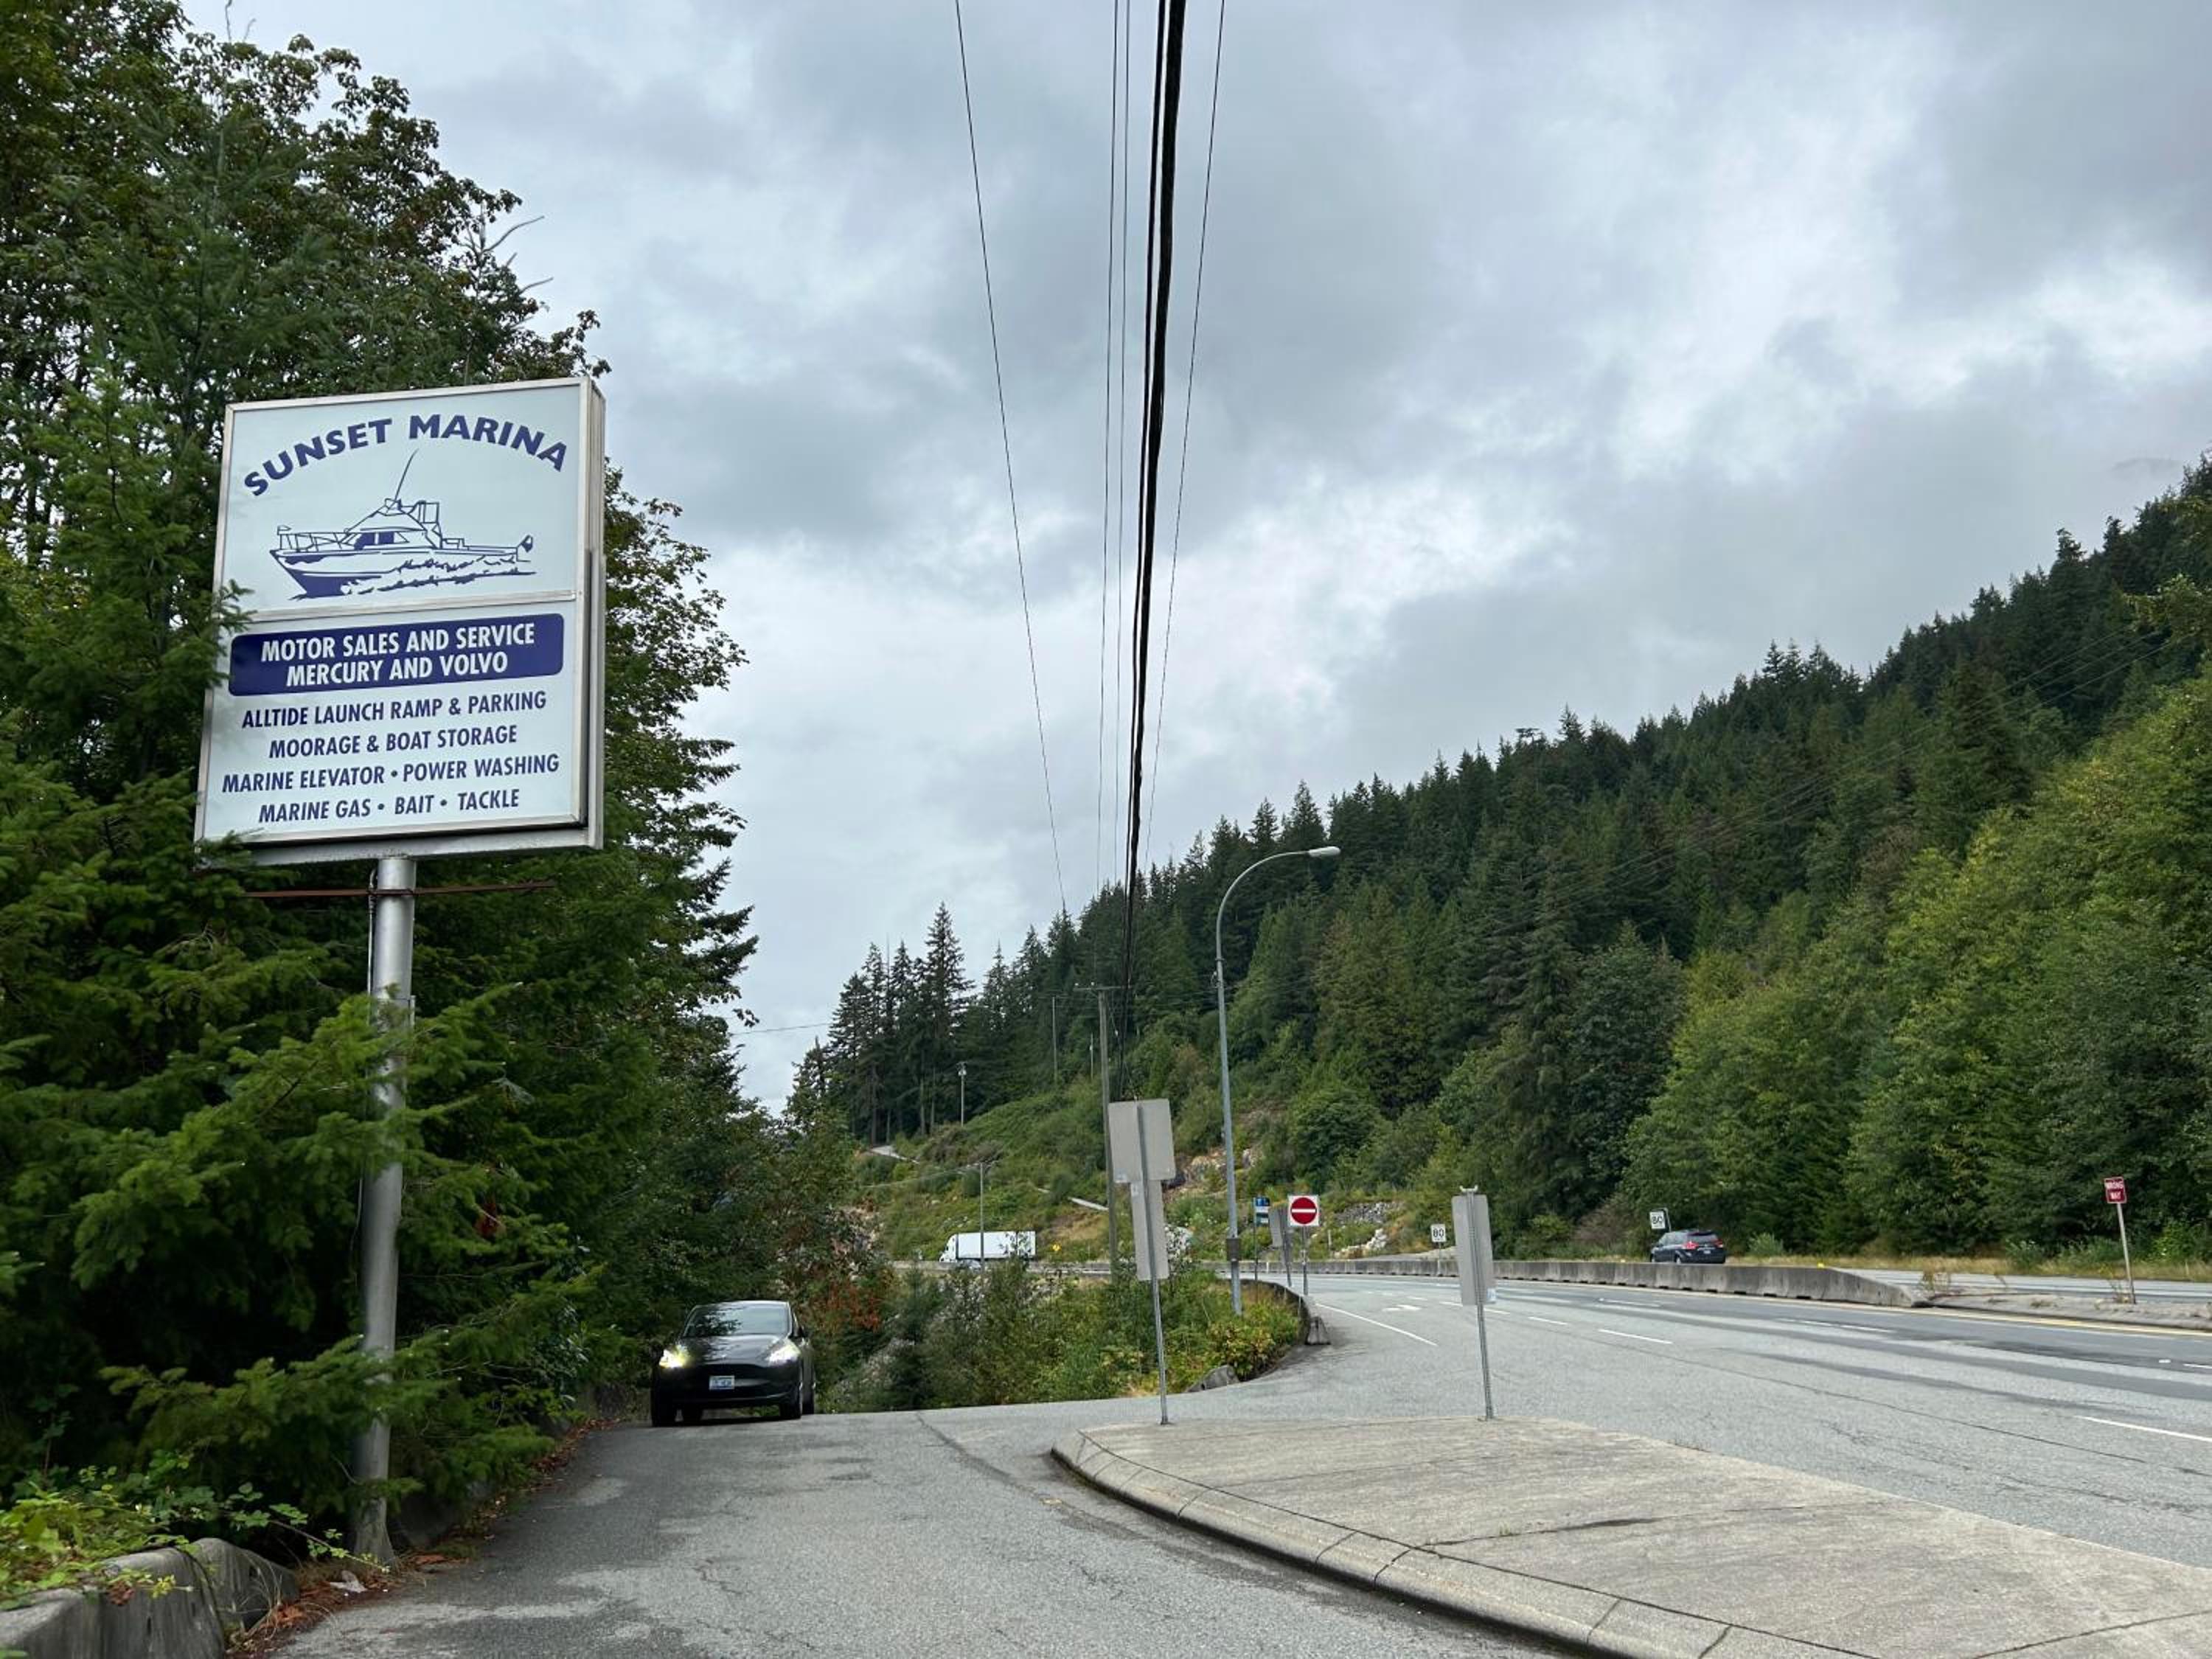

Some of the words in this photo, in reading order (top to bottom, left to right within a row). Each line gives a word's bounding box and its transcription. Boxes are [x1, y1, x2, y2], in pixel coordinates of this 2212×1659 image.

[244, 418, 393, 497] SUNSET
[408, 414, 567, 473] MARINA
[261, 636, 335, 662] MOTOR
[343, 632, 400, 657] SALES
[406, 629, 449, 653] AND
[456, 622, 535, 650] SERVICE
[286, 660, 383, 687] MERCURY
[389, 657, 433, 681] AND
[439, 651, 508, 676] VOLVO
[241, 706, 309, 730] ALLTIDE
[314, 702, 384, 725] LAUNCH
[390, 698, 443, 720] RAMP
[448, 697, 462, 716] &
[468, 690, 546, 714] PARKING
[268, 735, 361, 759] MOORAGE
[366, 734, 380, 753] &
[386, 731, 431, 751] BOAT
[437, 724, 517, 748] STORAGE
[221, 771, 294, 793] MARINE
[300, 765, 385, 789] ELEVATOR
[403, 761, 467, 782] POWER
[474, 753, 560, 778] WASHING
[258, 801, 330, 824] MARINE
[335, 799, 371, 818] GAS
[394, 794, 435, 815] BAIT
[457, 788, 520, 811] TACKLE
